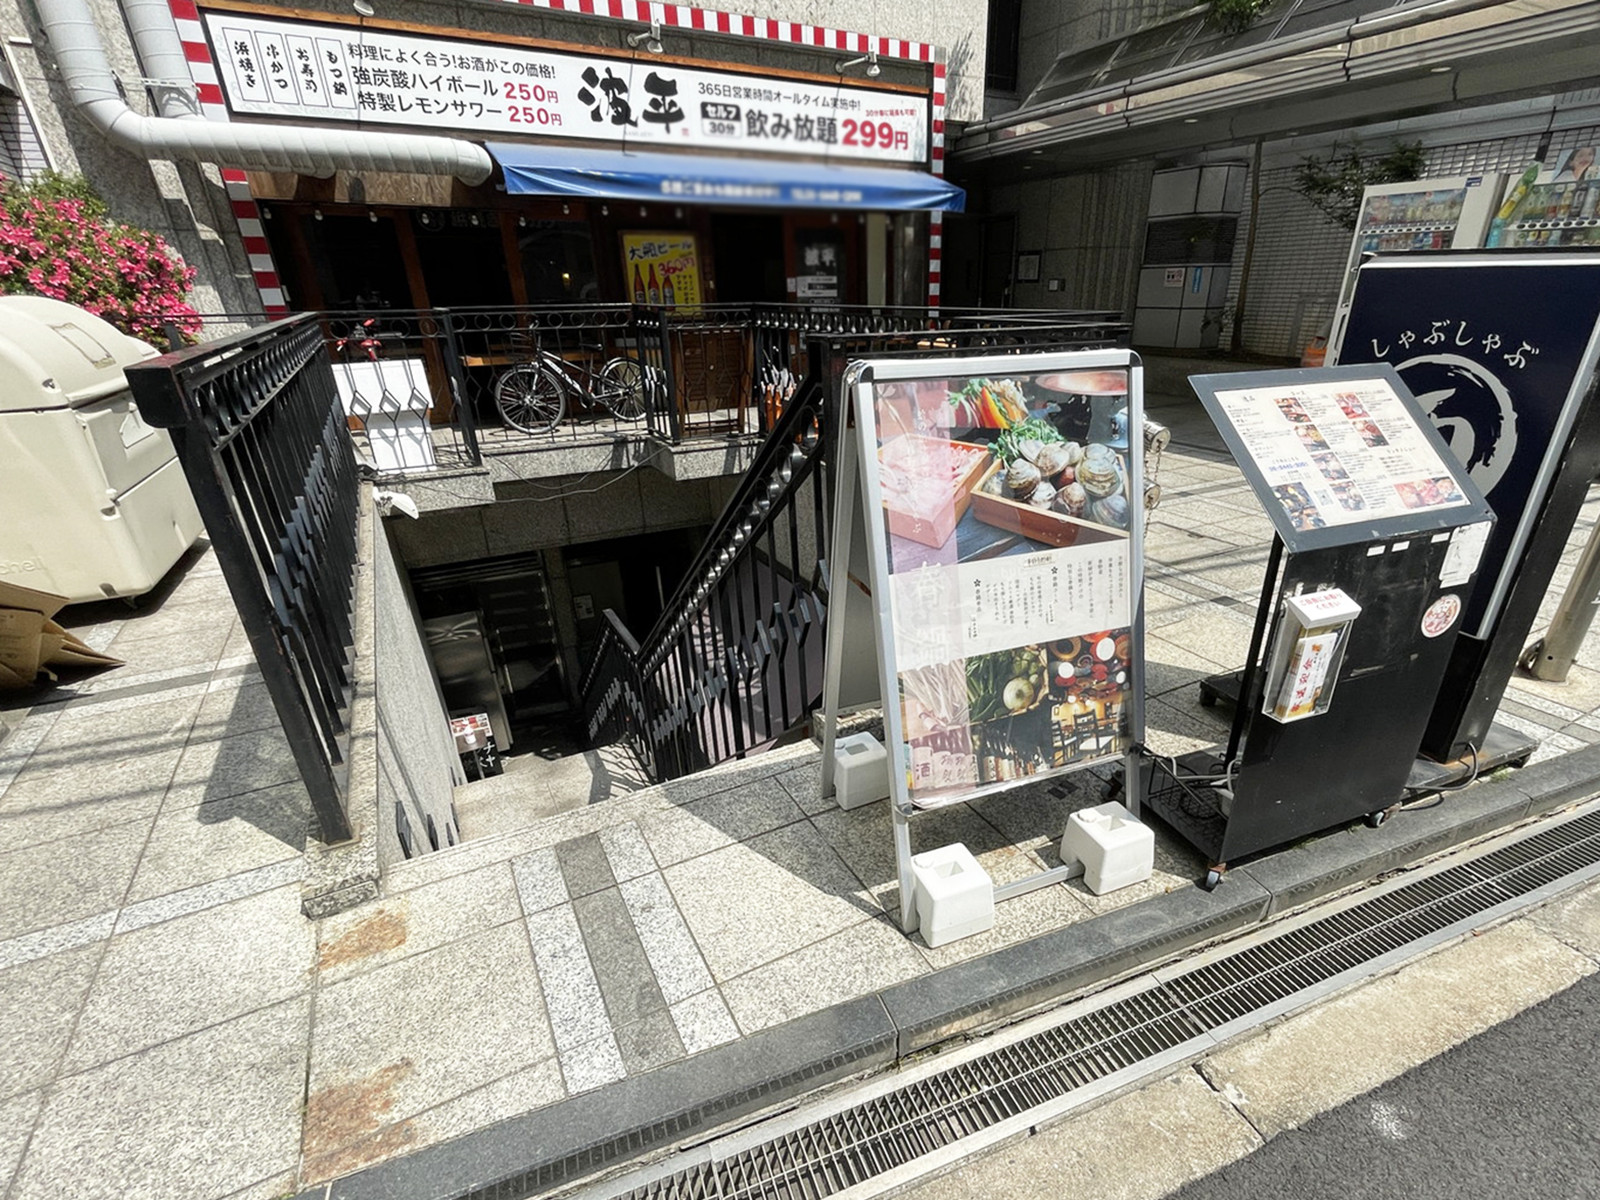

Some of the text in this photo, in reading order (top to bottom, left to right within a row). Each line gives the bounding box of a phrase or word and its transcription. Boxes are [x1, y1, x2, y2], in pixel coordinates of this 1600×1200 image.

[234, 40, 256, 88] 浜焼き
[266, 43, 289, 89] 串かつ
[295, 47, 318, 93] お寿司
[326, 50, 348, 96] もつ鍋
[351, 66, 559, 104] 強炭酸ハイボール 250円
[358, 90, 562, 126] 特製レモンサワー 250円
[577, 66, 685, 134] 波平
[706, 104, 738, 119] セルフ
[708, 121, 735, 134] 30分
[745, 109, 909, 150] 飲み放題 299円
[1370, 319, 1540, 369] しゃぶしゃぶ
[915, 762, 931, 780] 酒
